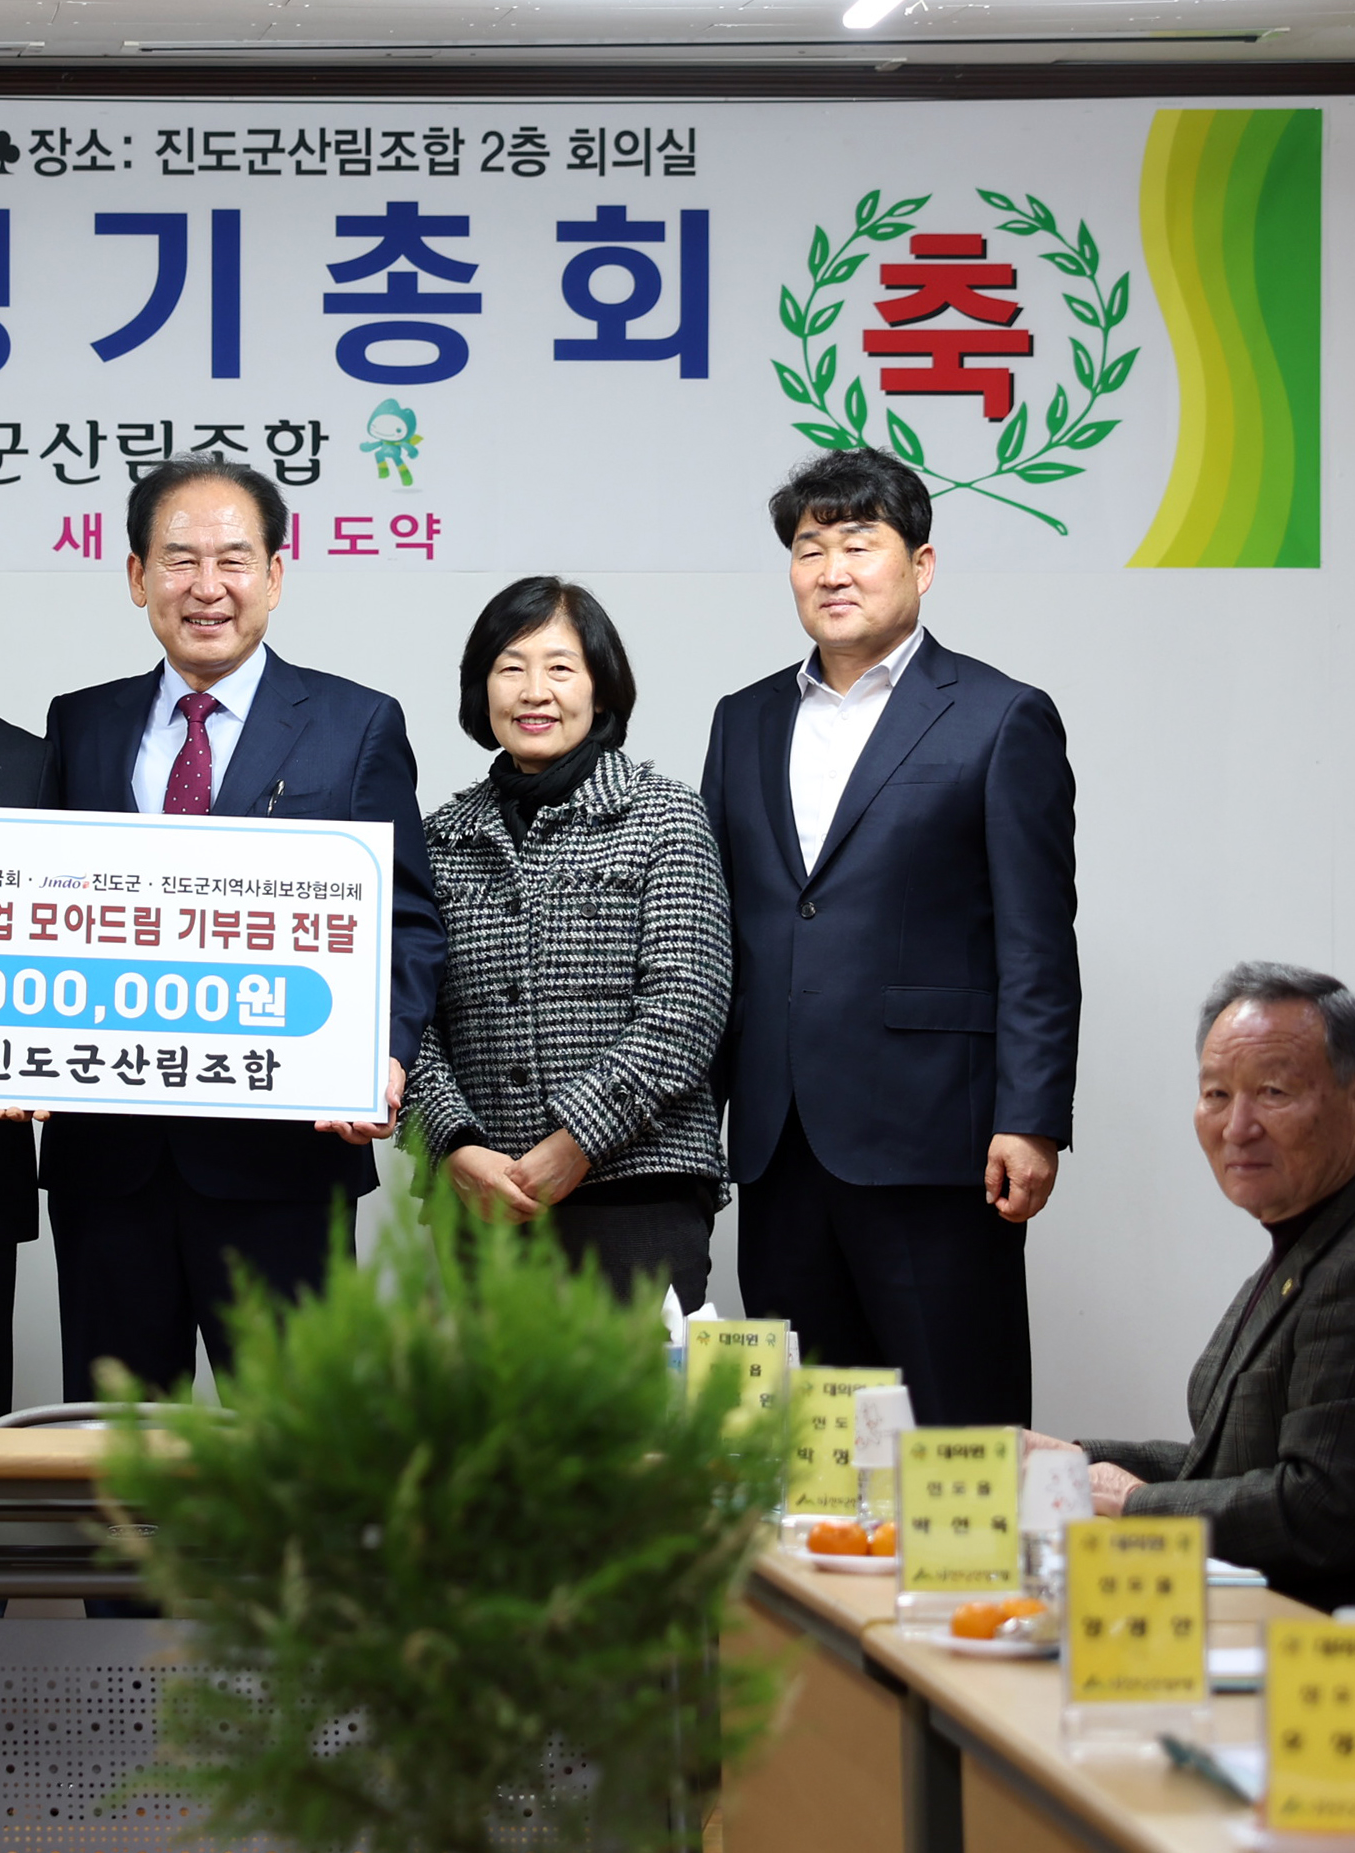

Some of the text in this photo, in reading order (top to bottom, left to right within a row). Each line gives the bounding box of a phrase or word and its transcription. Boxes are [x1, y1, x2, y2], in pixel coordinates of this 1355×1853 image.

[27, 126, 698, 178] 장소: 진도군산림조합 2층 회의실
[862, 233, 1034, 423] 축
[327, 511, 443, 561] 도약
[92, 872, 142, 894] 진도군
[161, 874, 363, 902] 진도군지역사회보장협의체
[29, 901, 162, 947] 모아드림
[178, 907, 276, 951] 기부금
[292, 911, 358, 954] 전달
